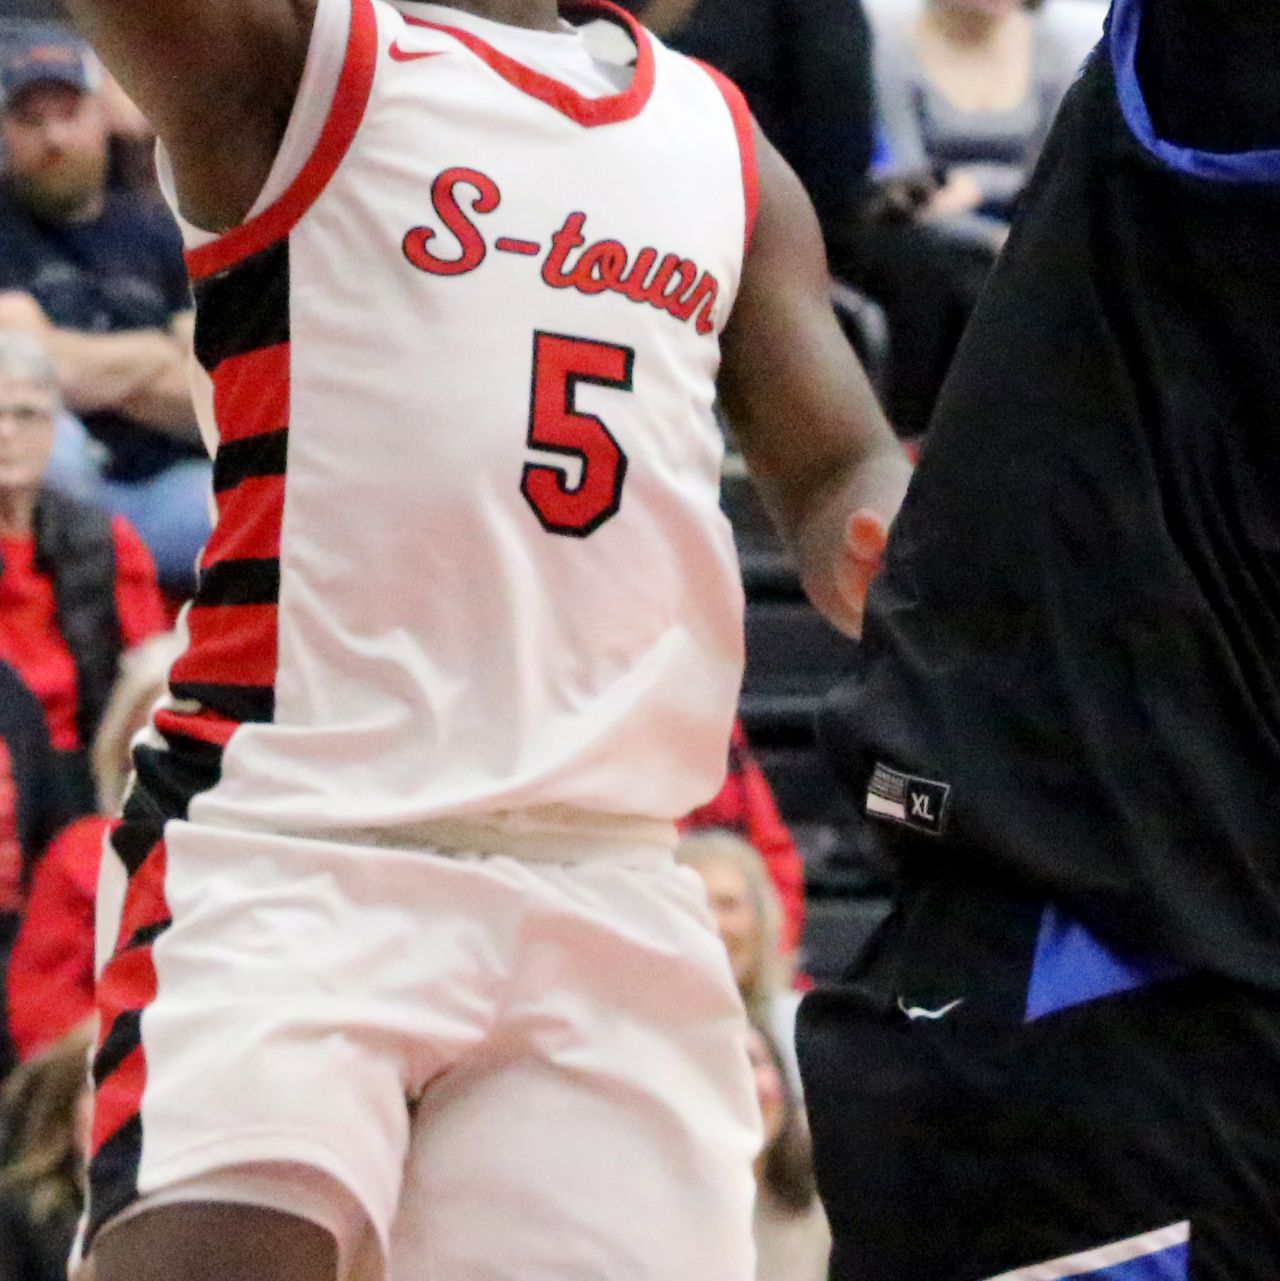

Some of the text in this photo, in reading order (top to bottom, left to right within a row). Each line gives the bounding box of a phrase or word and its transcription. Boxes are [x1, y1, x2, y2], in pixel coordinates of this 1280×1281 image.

[401, 166, 719, 335] S-town
[520, 329, 635, 538] 5
[911, 791, 935, 821] XL
